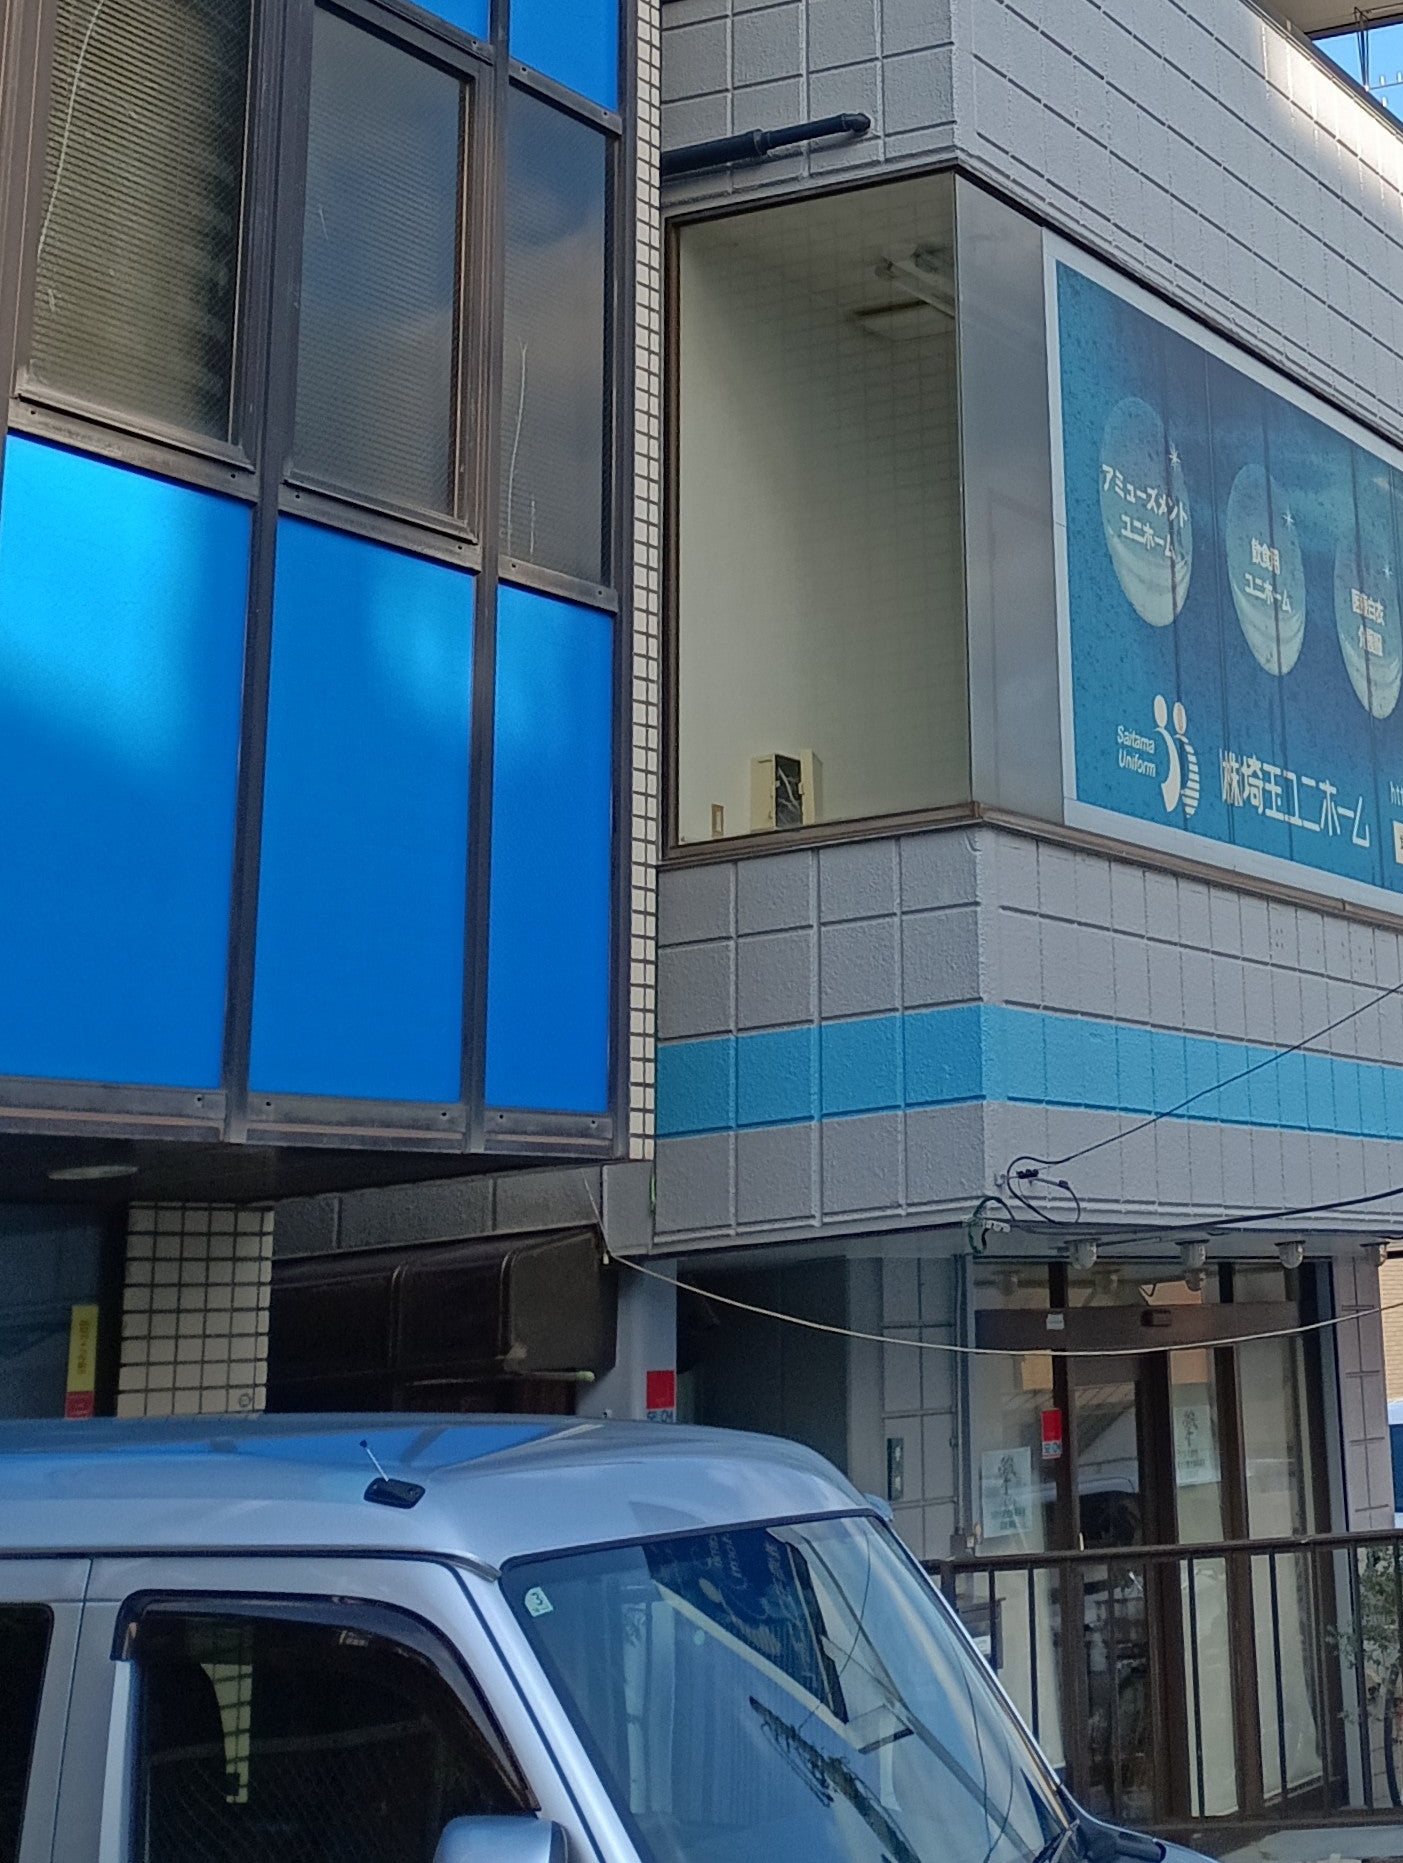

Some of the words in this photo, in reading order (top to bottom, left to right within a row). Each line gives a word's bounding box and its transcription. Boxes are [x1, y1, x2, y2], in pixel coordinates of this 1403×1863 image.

[1102, 463, 1188, 528] アミューズメント
[1120, 513, 1177, 561] ユニホーム
[1244, 572, 1292, 614] ユニホーム
[1116, 724, 1156, 754] Saitama
[1118, 748, 1157, 778] Uniform
